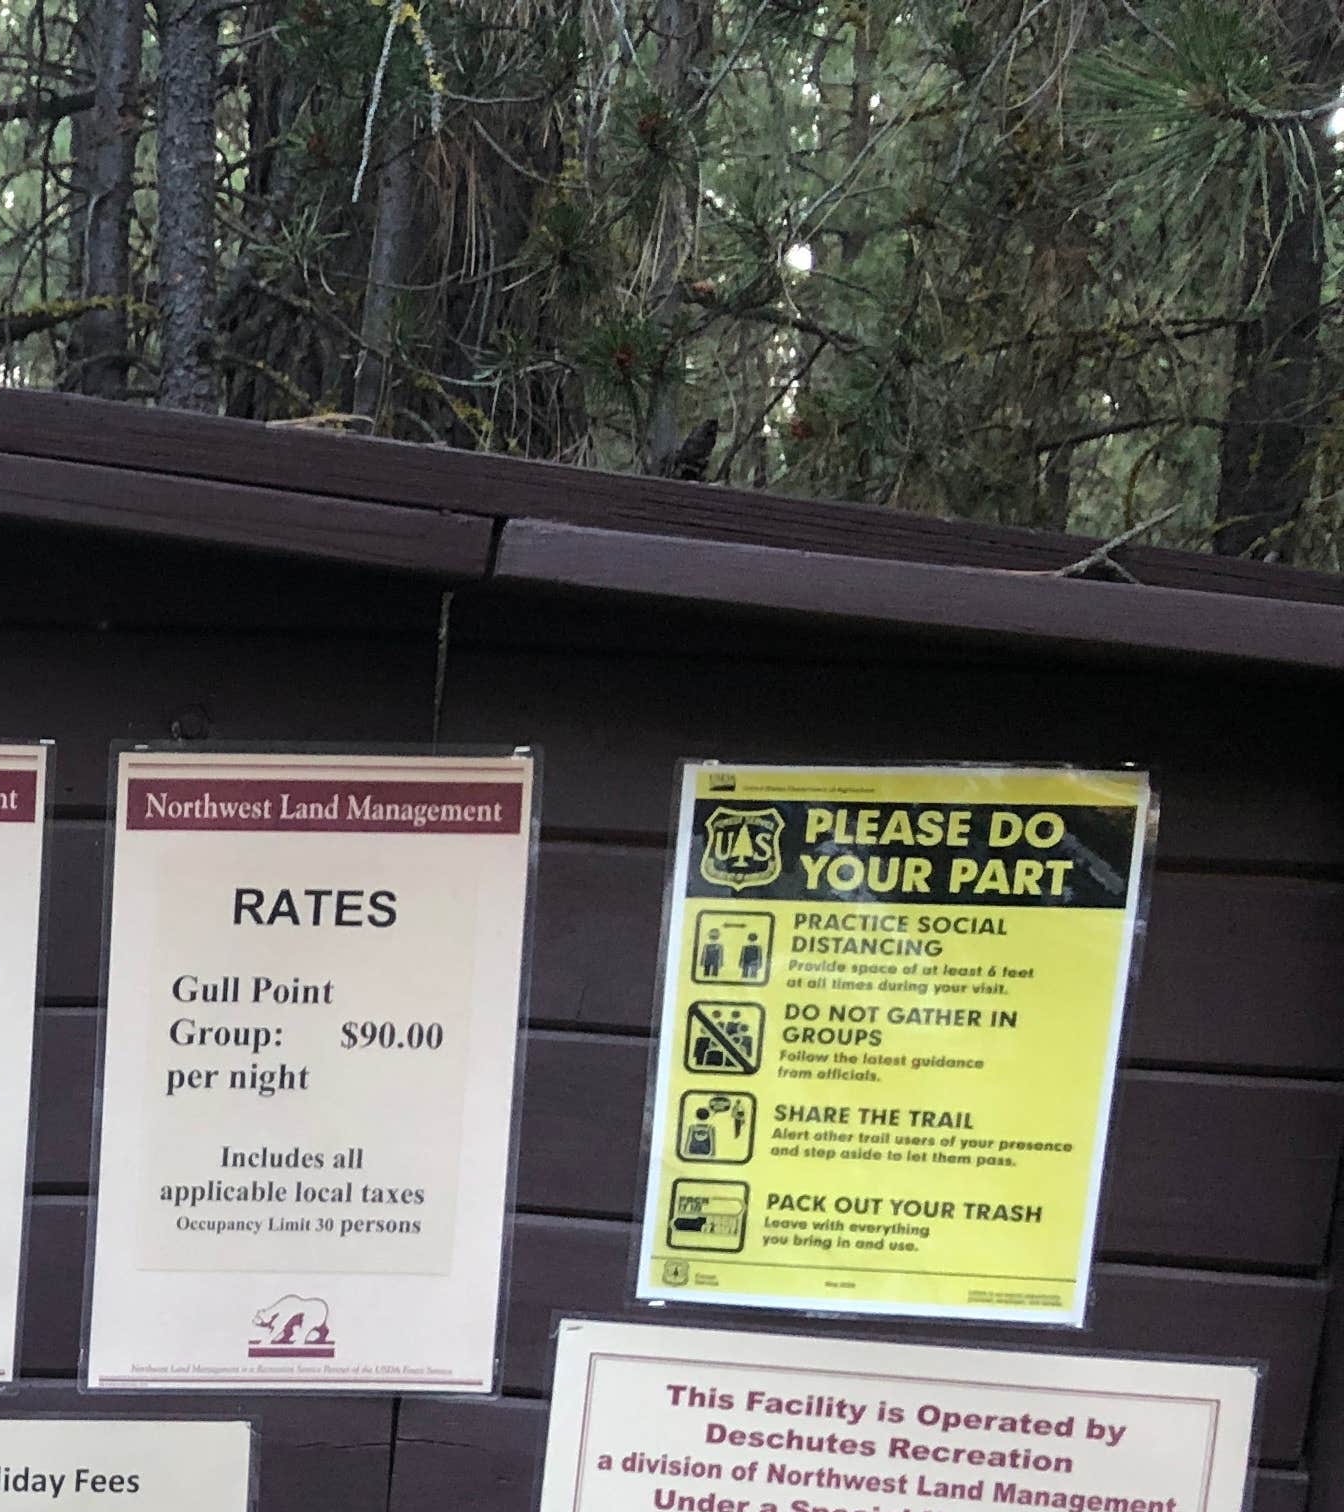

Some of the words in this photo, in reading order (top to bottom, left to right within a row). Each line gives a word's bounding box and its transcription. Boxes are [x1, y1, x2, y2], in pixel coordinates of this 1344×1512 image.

[805, 807, 972, 852] PLEASE
[988, 811, 1065, 849] DO
[799, 853, 933, 896] YOUR
[948, 857, 1074, 896] PART
[793, 912, 910, 933] PRACTICE
[917, 915, 1007, 936] SOCIAL
[791, 935, 944, 958] DISTANCING
[172, 975, 240, 1003] Gull
[252, 977, 332, 1004] Point
[169, 1018, 282, 1054] Group:
[340, 1021, 443, 1050] $90.00
[774, 1104, 851, 1125] SHARE
[858, 1107, 901, 1127] THE
[908, 1109, 974, 1130] TRAIL
[771, 1127, 810, 1142] Alert
[812, 1130, 855, 1143] other
[858, 1132, 891, 1145] trail
[894, 1135, 936, 1147] users
[939, 1135, 957, 1148] of
[959, 1138, 995, 1150] your
[998, 1140, 1073, 1153] presence
[176, 1216, 261, 1235] Occupancy
[268, 1217, 311, 1232] Limit
[314, 1217, 335, 1232] 30
[340, 1218, 421, 1238] persons
[666, 1384, 735, 1411] This
[746, 1390, 867, 1426] Facility
[877, 1400, 905, 1424] is
[916, 1404, 1075, 1438] Operated
[1085, 1417, 1127, 1448] by
[705, 1423, 876, 1457] Deschutes
[888, 1437, 1073, 1474] Recreation
[74, 1468, 140, 1494] Fees
